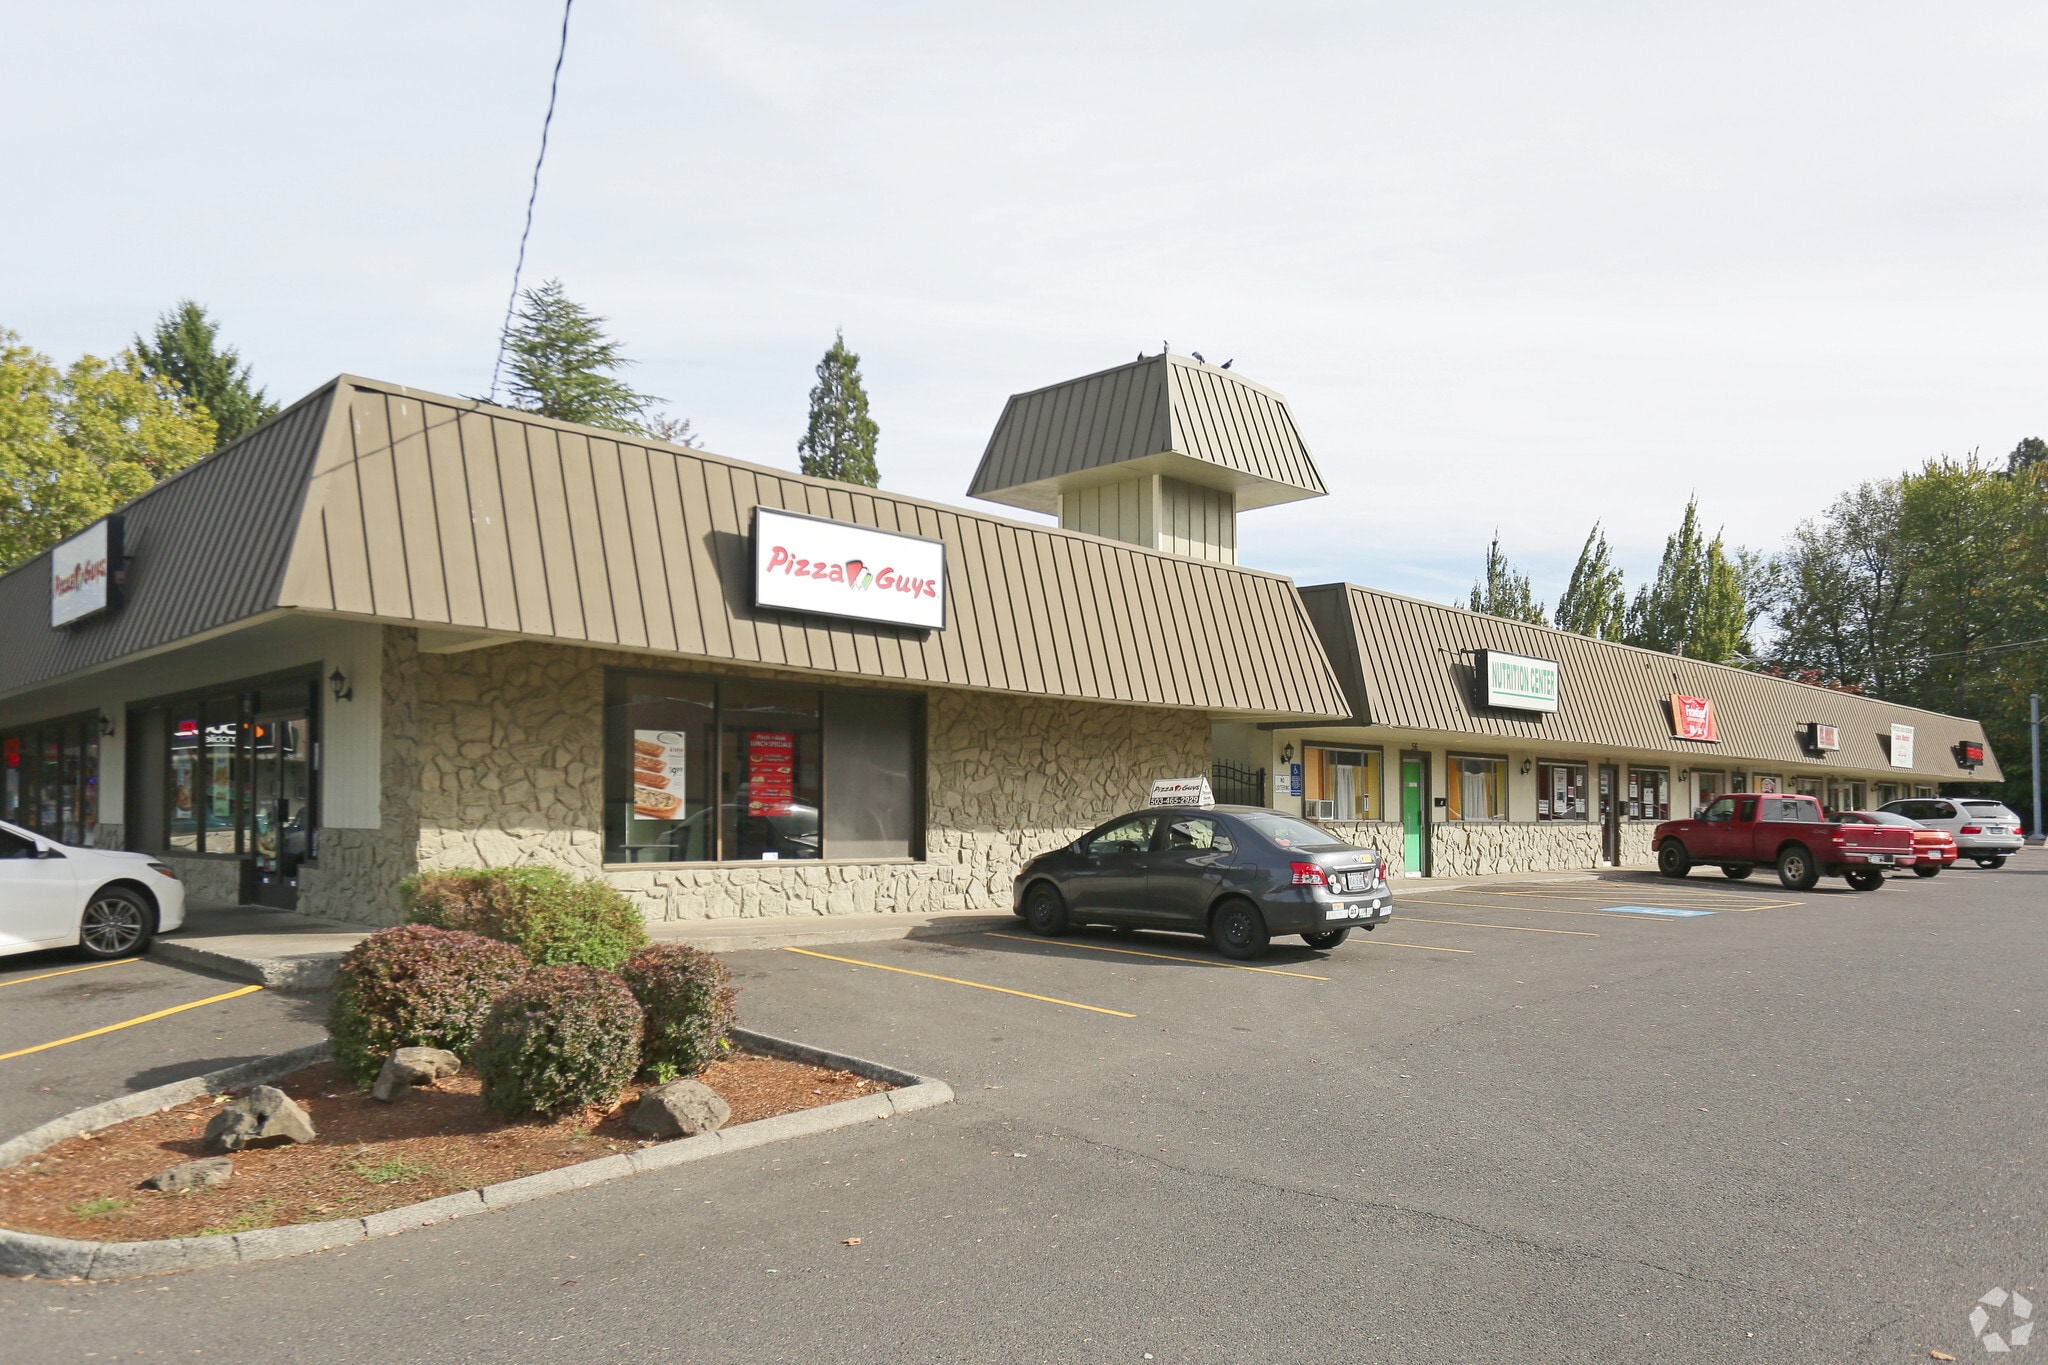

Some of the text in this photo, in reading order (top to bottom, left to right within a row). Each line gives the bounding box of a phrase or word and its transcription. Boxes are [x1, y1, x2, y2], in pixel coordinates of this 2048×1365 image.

[766, 545, 937, 599] Pizza Guys
[1491, 661, 1555, 696] NUTRITION CENTER
[1150, 796, 1199, 805] 503-465-2929
